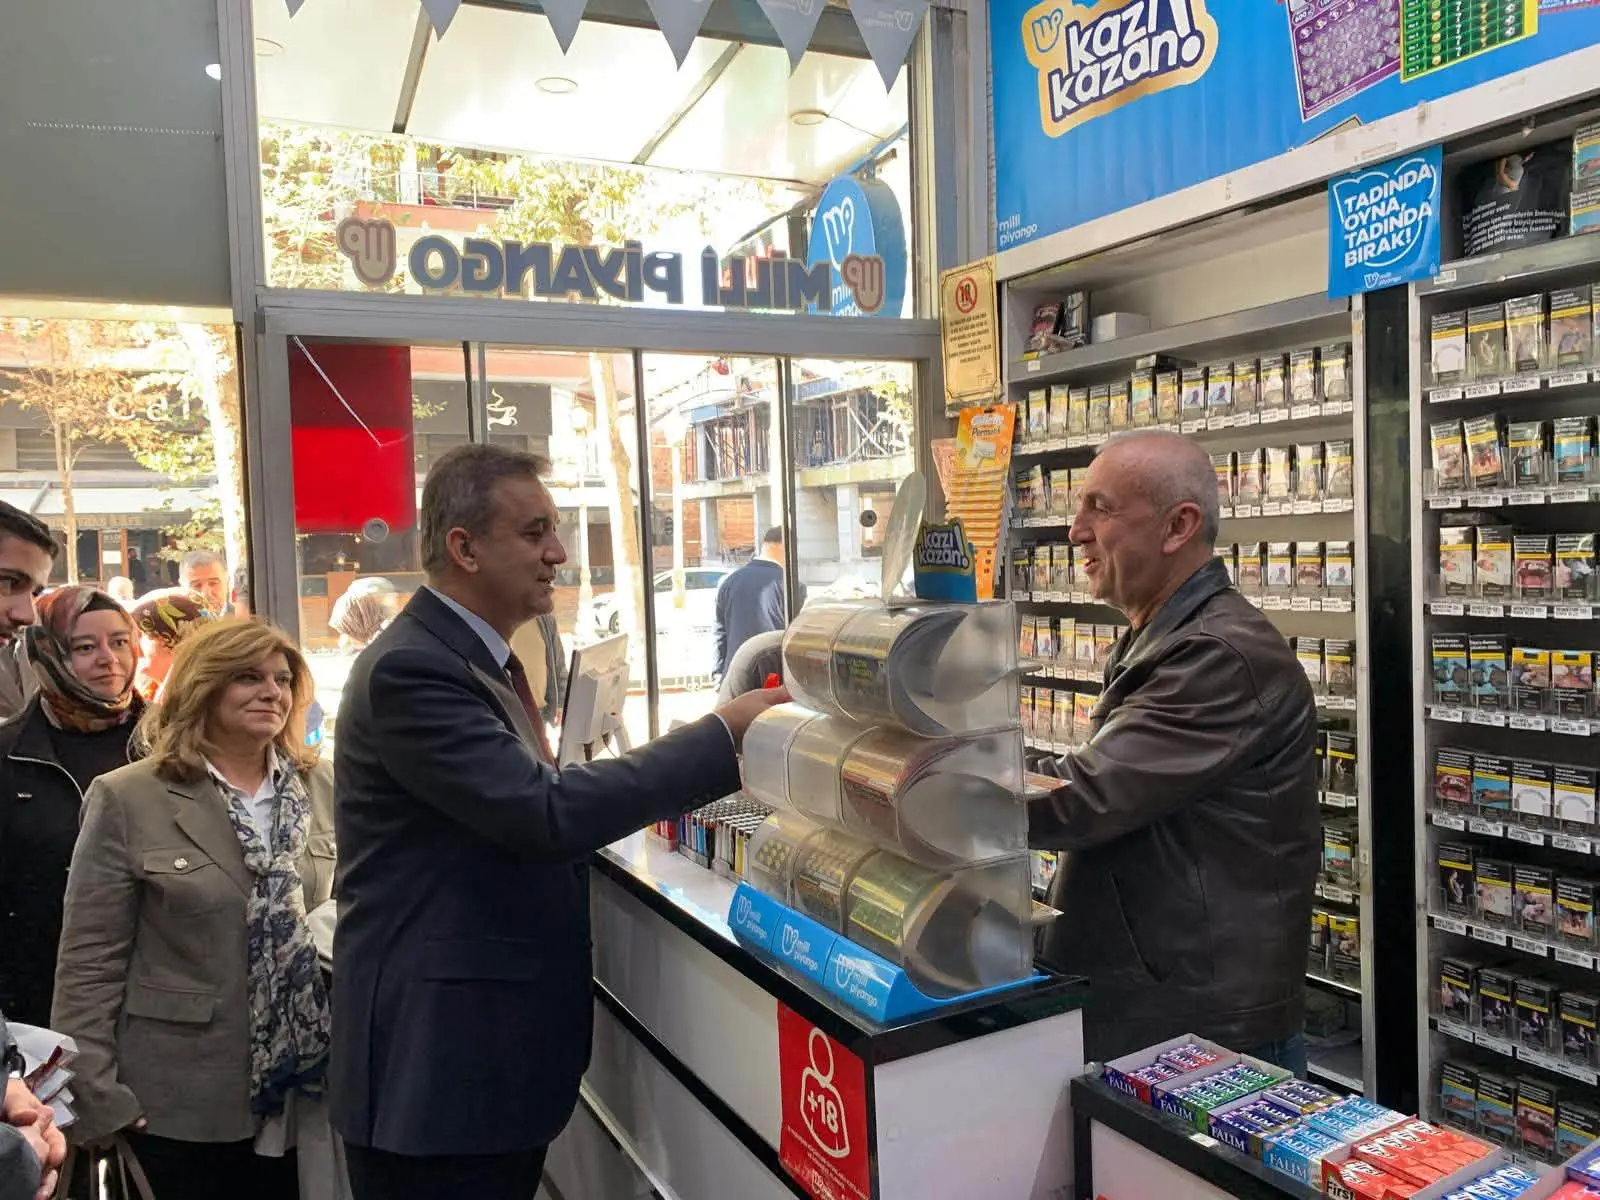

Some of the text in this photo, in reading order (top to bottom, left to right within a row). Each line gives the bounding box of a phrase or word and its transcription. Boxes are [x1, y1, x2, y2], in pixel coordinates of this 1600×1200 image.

[1344, 163, 1432, 213] TADINDA
[1344, 197, 1407, 231] OYNA,
[1344, 201, 1432, 249] TADINDA
[1000, 223, 1038, 247] piyango
[1344, 227, 1411, 268] BIRAK!
[1110, 1075, 1137, 1097] FALIM
[808, 1090, 839, 1134] +18
[1161, 1099, 1192, 1121] FALIM
[1212, 1126, 1245, 1152] FALIM
[1270, 1153, 1307, 1181] FALIM
